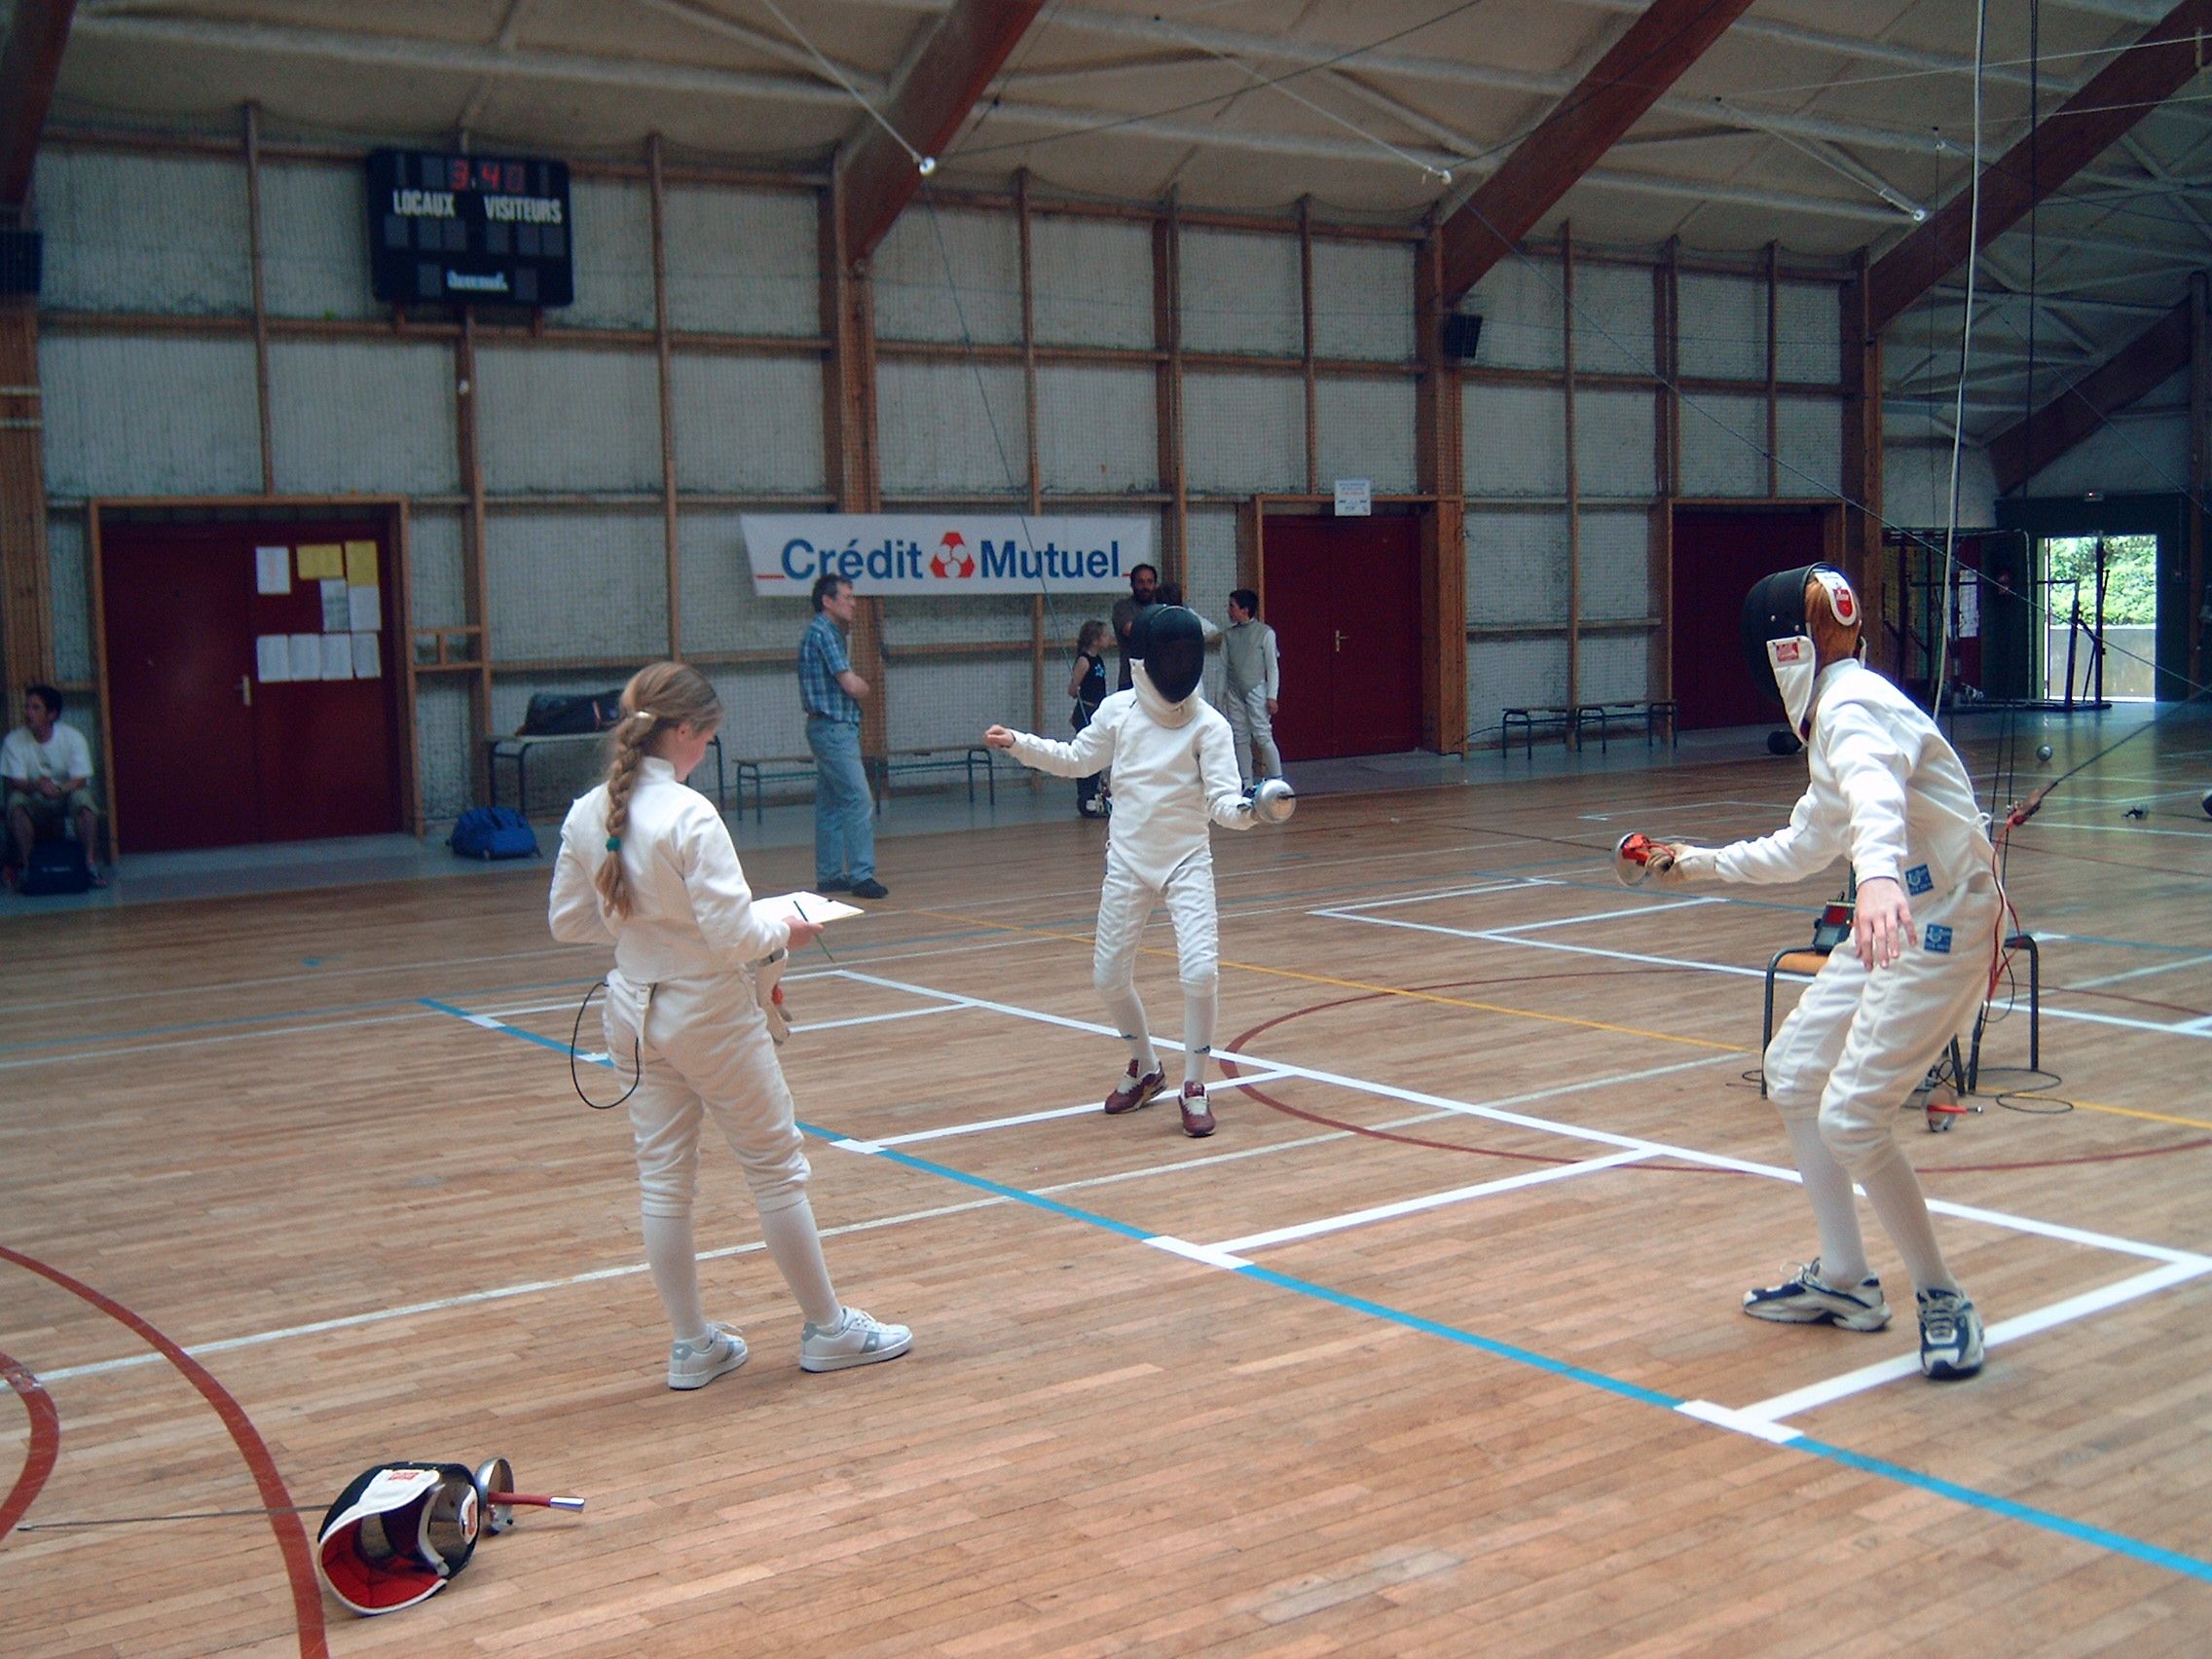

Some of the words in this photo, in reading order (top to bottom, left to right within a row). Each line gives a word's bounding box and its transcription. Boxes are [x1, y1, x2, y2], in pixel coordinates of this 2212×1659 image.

[392, 189, 456, 219] LOCAUX
[483, 196, 563, 226] VISITEURS
[782, 538, 924, 580] Crédit
[980, 539, 1120, 579] Mutuel
